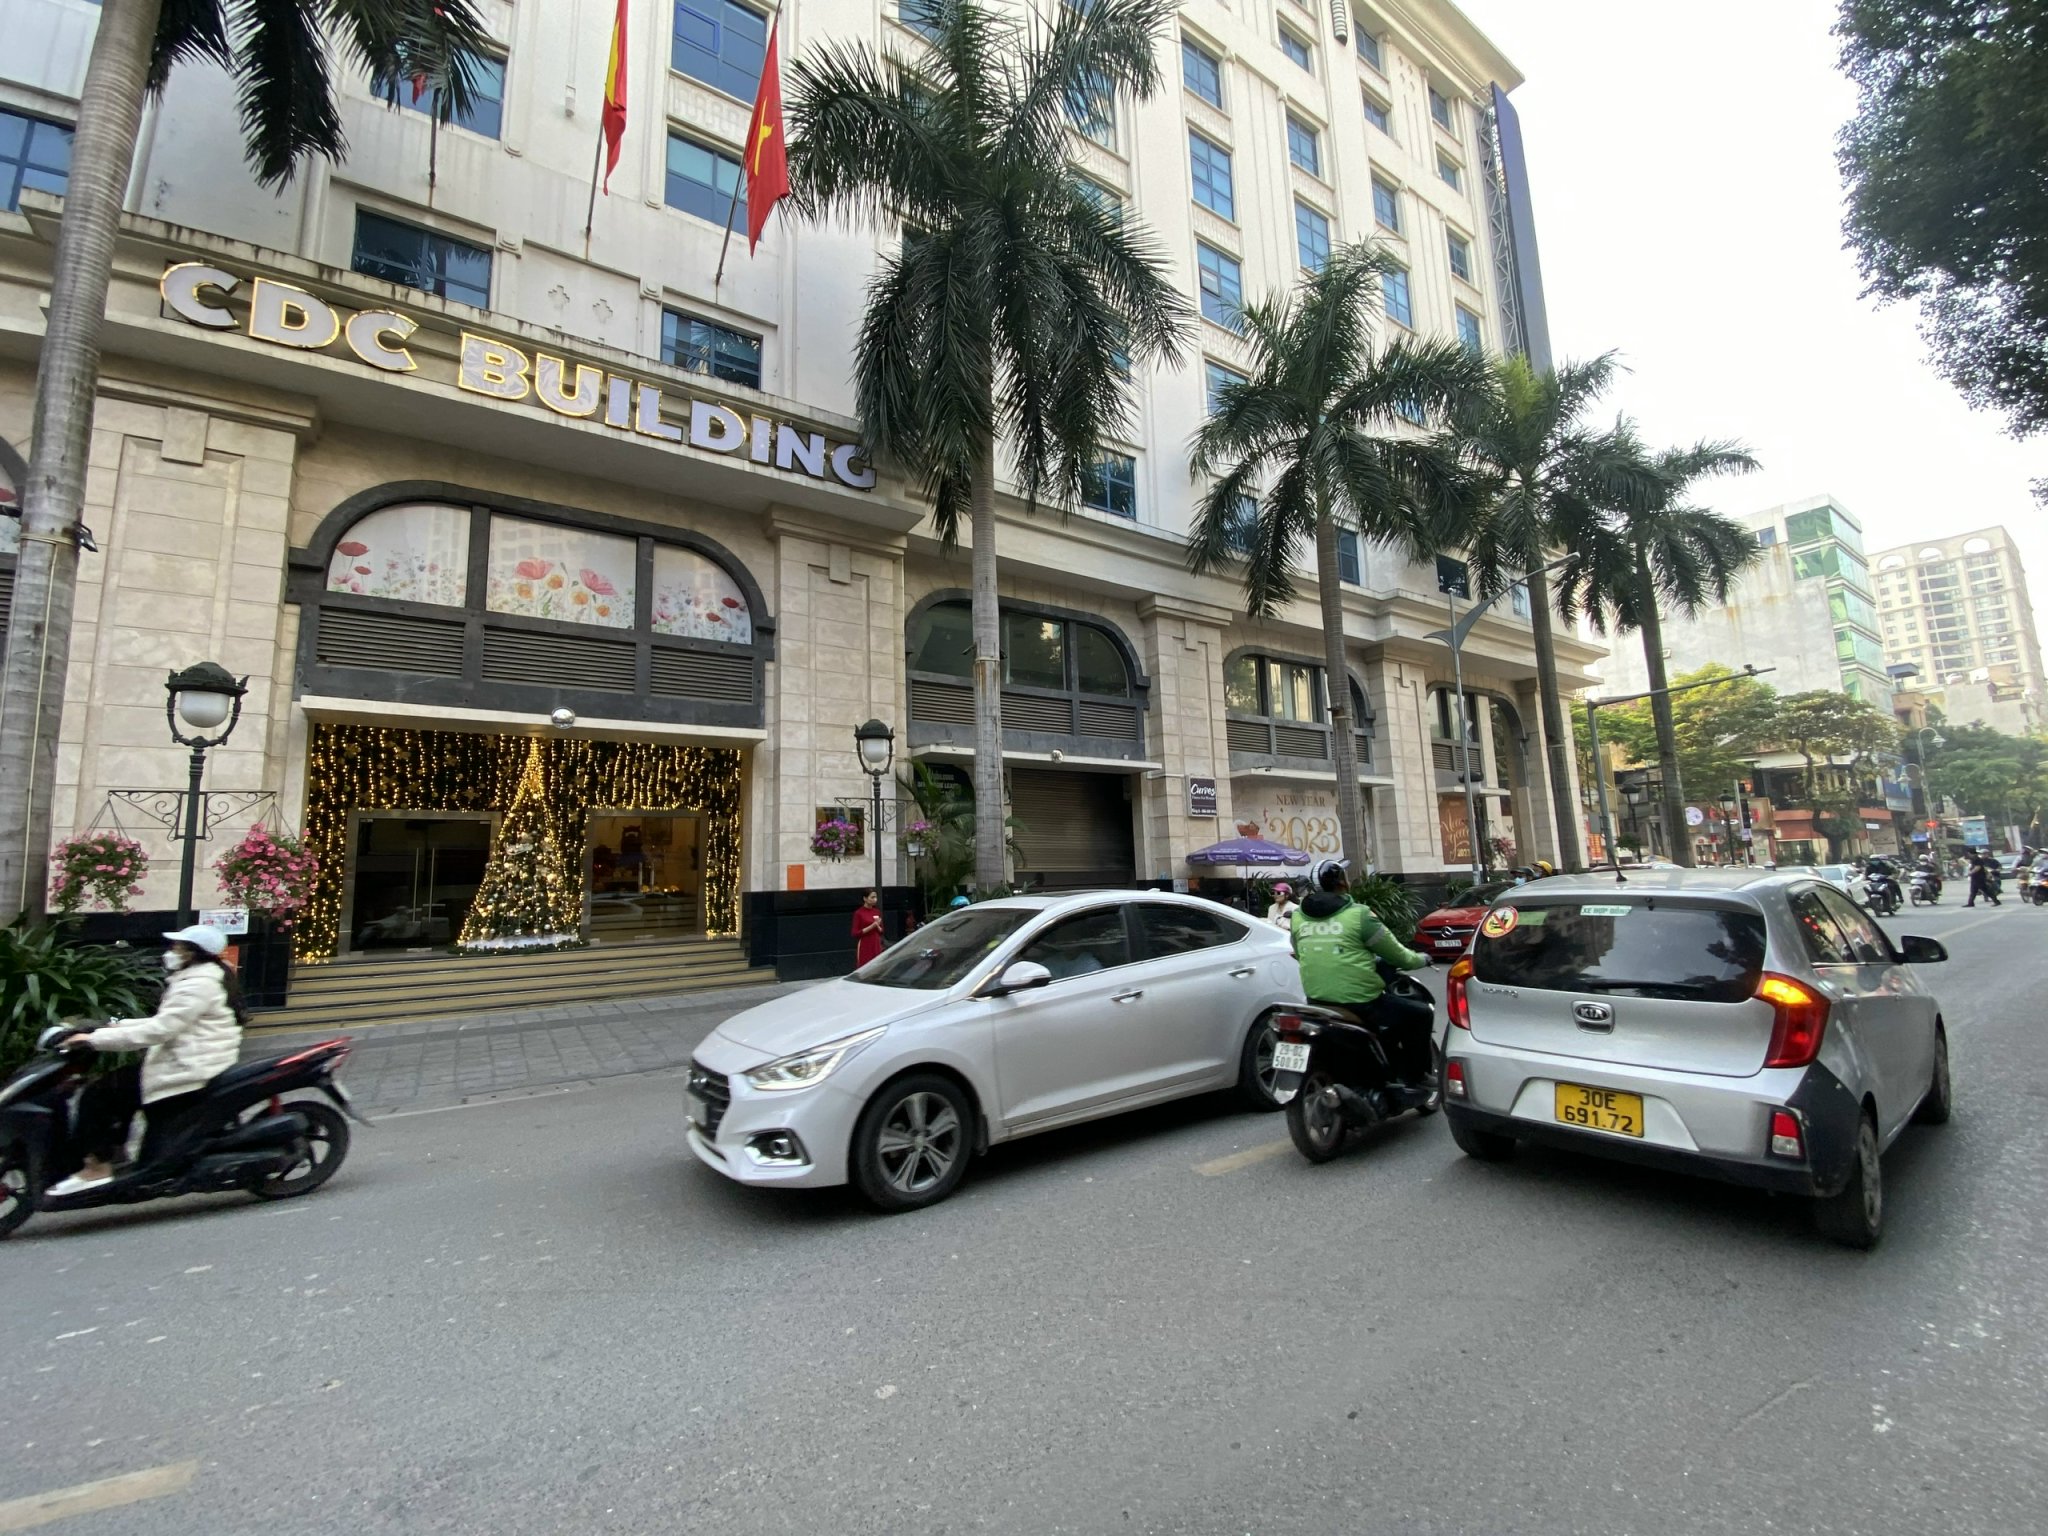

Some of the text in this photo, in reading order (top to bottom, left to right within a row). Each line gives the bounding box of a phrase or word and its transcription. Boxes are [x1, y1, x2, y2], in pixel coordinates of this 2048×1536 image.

[160, 262, 877, 492] CDC BUILDING
[1191, 784, 1215, 796] Curves
[1276, 795, 1326, 807] NEW YEAR
[1269, 816, 1341, 854] 2023
[1300, 918, 1344, 937] Grab
[1580, 1007, 1604, 1019] KIA
[1579, 1089, 1617, 1111] 30E
[1564, 1105, 1633, 1133] 691.72
